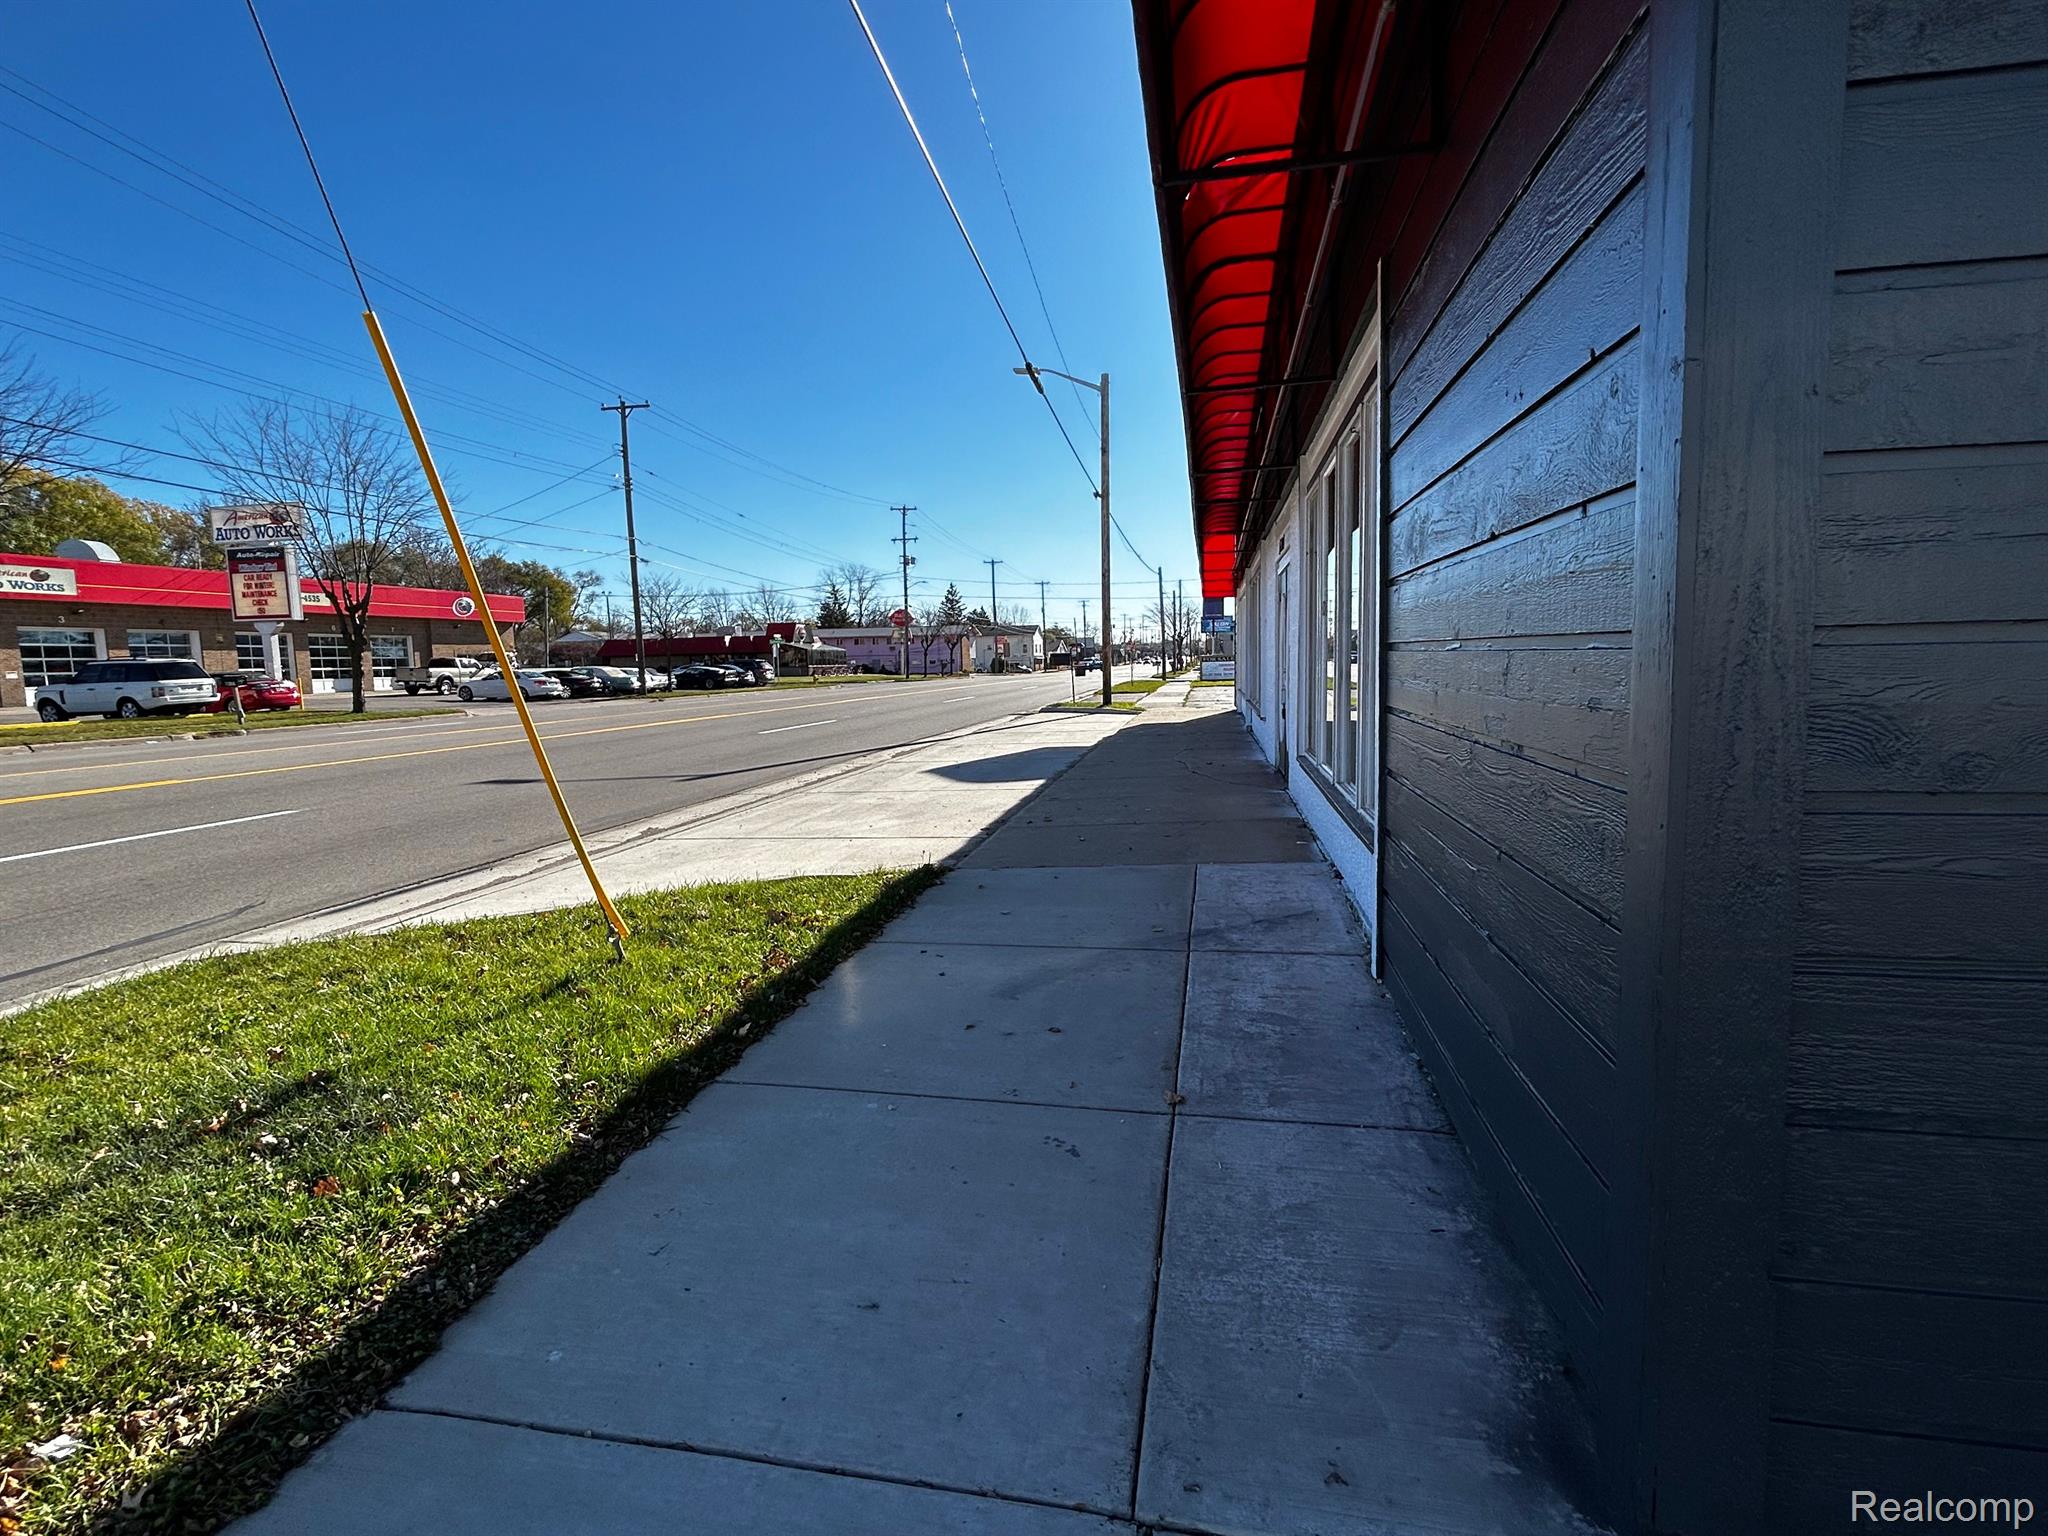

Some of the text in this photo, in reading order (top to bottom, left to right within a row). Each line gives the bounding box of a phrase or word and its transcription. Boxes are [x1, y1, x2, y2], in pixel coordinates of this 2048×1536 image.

[223, 511, 270, 526] American
[215, 525, 300, 541] AUTO WORKS
[7, 580, 65, 592] WORKS
[243, 582, 253, 590] FOR
[241, 590, 277, 598] MAINTENANCE
[58, 615, 65, 624] 3
